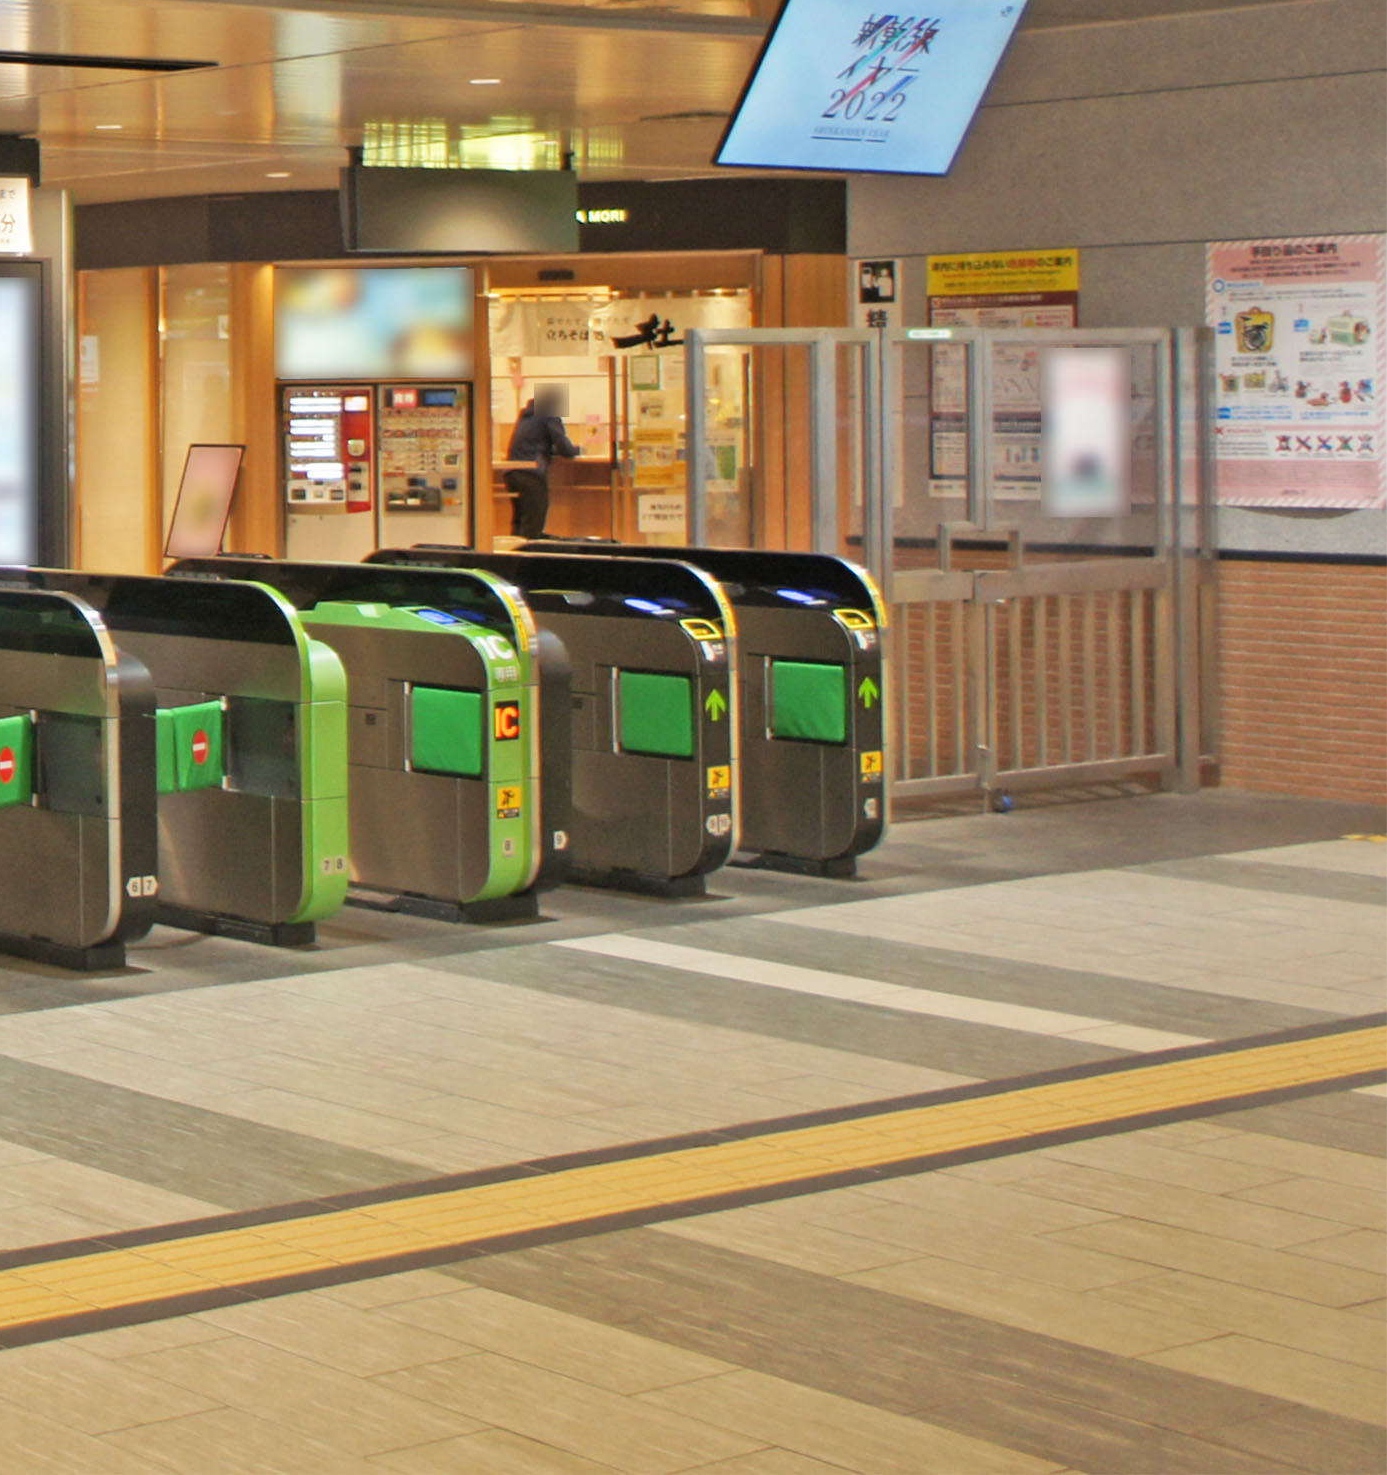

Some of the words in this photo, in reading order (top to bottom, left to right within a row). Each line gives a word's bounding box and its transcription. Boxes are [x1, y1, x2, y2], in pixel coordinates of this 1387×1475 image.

[821, 89, 907, 123] 2022
[475, 635, 515, 660] IC
[494, 705, 520, 739] IC
[131, 879, 140, 894] 6
[144, 877, 154, 892] 7
